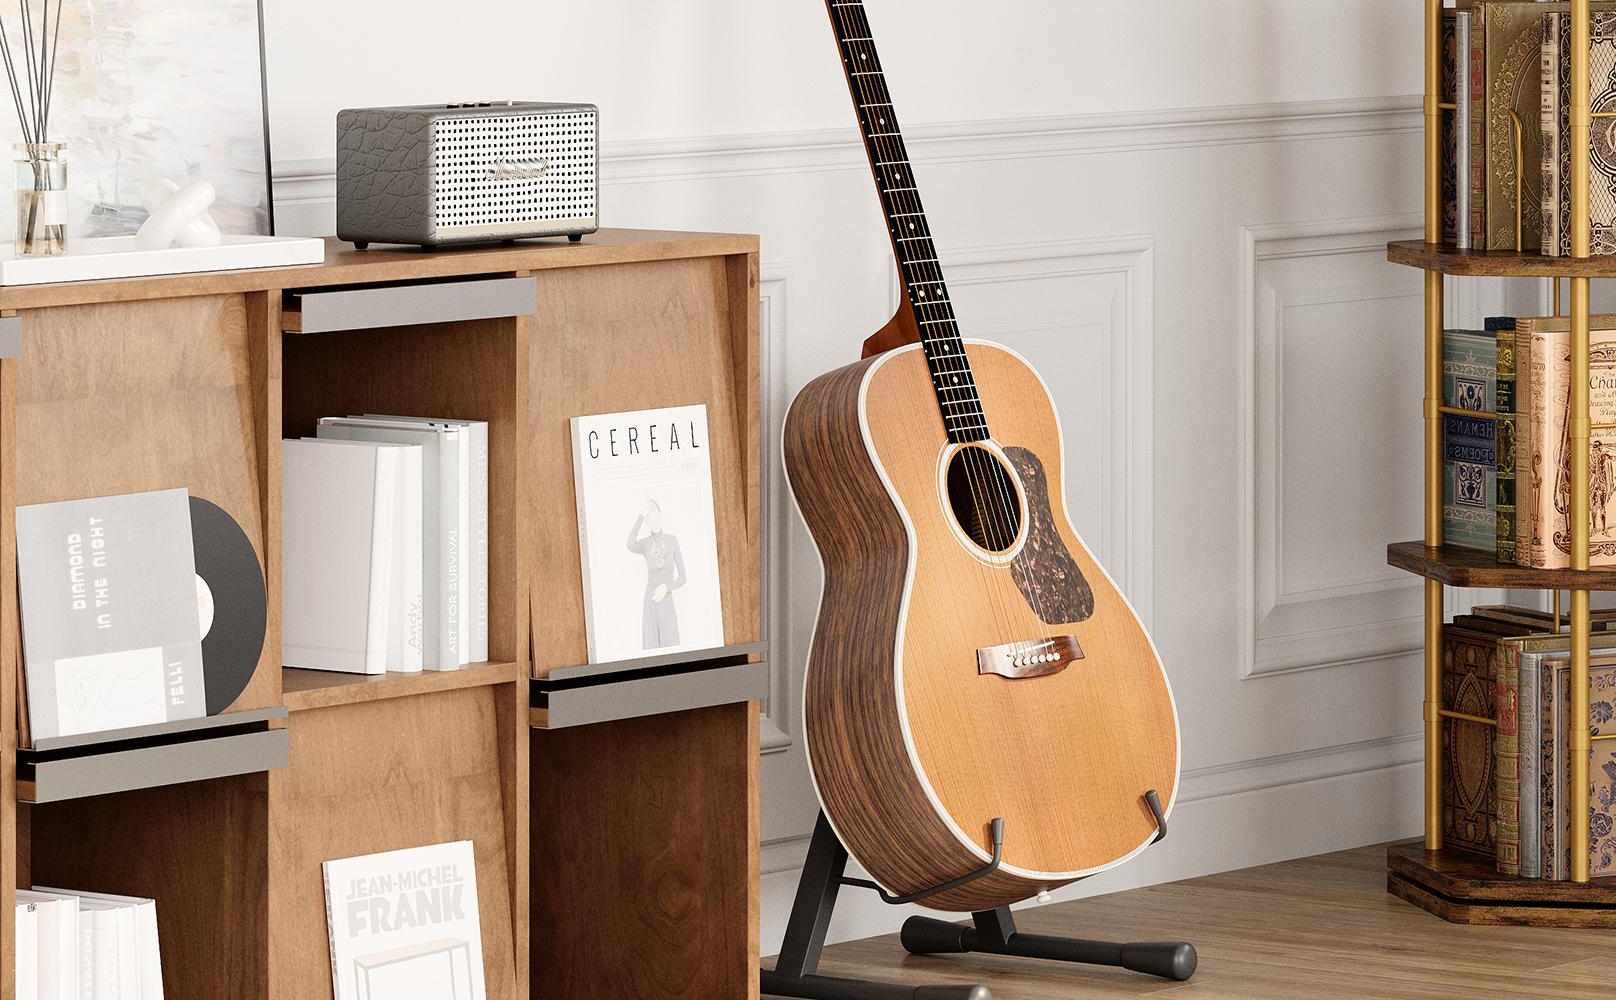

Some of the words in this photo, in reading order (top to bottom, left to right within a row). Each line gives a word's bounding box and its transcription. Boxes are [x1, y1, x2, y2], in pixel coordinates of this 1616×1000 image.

[588, 421, 700, 459] CEREAL
[89, 516, 107, 567] NIGHT
[448, 527, 458, 594] SURVIVAL
[67, 532, 87, 611] DIAMOND
[94, 577, 110, 608] THE
[447, 598, 458, 624] FOR
[96, 613, 111, 629] IN
[407, 601, 418, 649] Andy
[447, 631, 458, 655] ART
[345, 863, 464, 900] JEAN-MICHEL
[346, 883, 466, 938] FRANK
